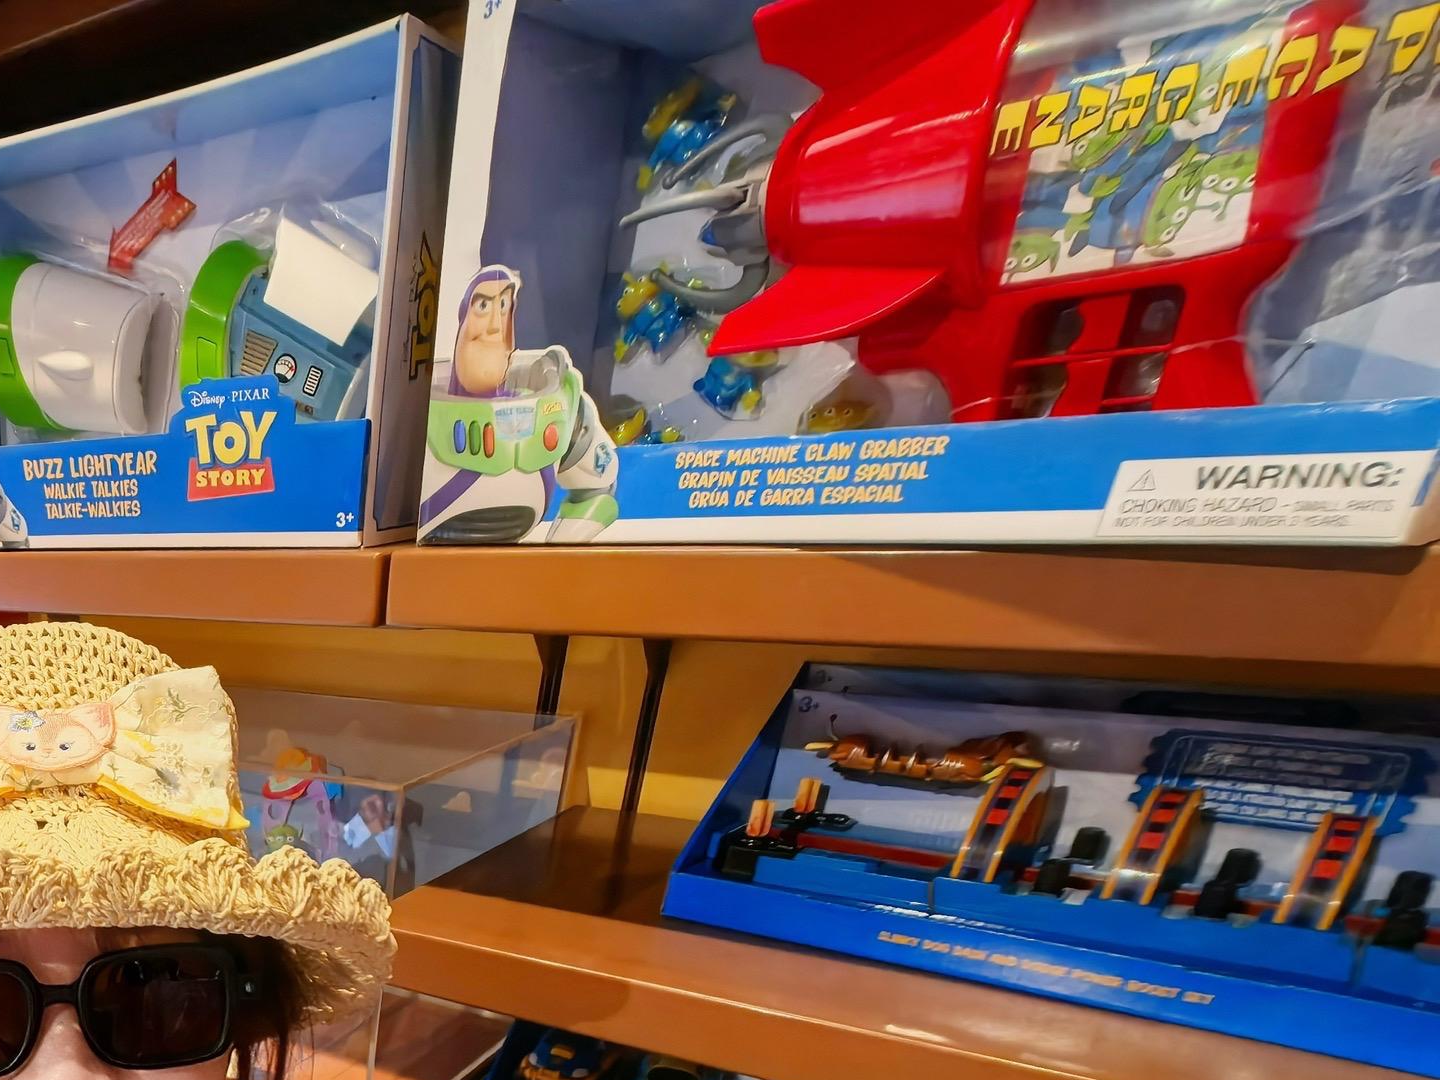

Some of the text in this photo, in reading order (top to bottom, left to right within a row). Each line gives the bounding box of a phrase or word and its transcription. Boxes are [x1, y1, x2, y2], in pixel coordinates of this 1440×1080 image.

[989, 1, 1440, 158] PACE CRANE
[231, 387, 270, 402] PIXAR
[184, 410, 278, 466] TOY
[675, 435, 951, 470] SPACE MACHINE CLAW GRABBER
[23, 450, 158, 481] BUZZ LIGHTYEAR
[195, 468, 266, 488] STORY
[678, 461, 929, 490] GRAPIN DE VAISSEAU SPATIAL
[1195, 461, 1405, 490] WARNING:
[43, 479, 139, 500] WALKIE TALKIES
[688, 484, 904, 509] GRÚA DE GARRA ESPACIAL
[45, 500, 142, 520] TALKIE-WALKIES
[1120, 497, 1198, 514] CHOKING
[1203, 496, 1278, 513] HAZARD
[335, 511, 356, 529] 3+
